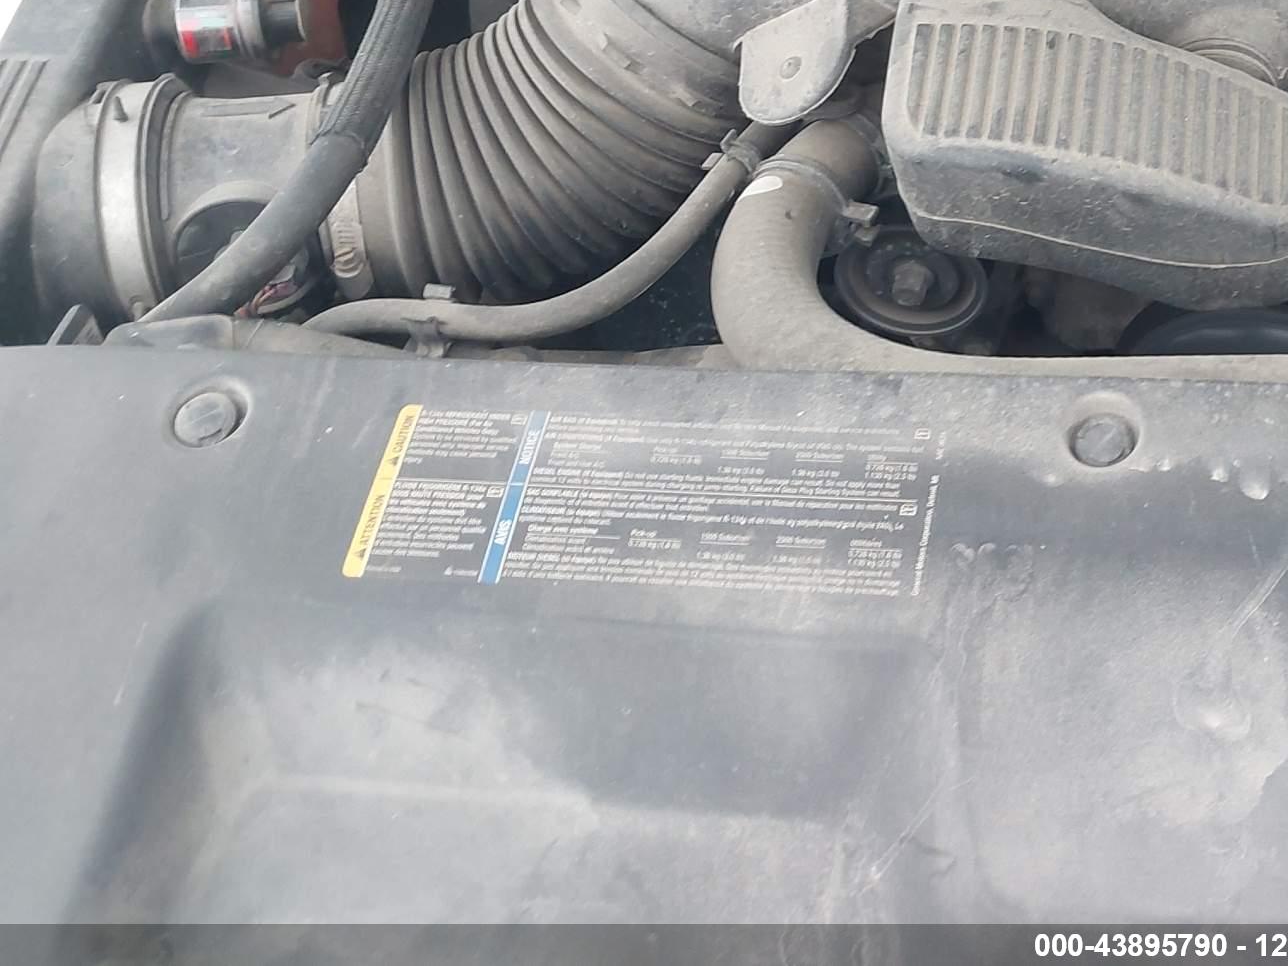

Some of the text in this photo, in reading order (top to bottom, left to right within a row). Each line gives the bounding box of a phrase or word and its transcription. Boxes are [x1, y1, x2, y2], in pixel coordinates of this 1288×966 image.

[392, 414, 415, 454] CAUTION
[519, 429, 541, 465] NOTICE
[364, 494, 386, 549] ATTENTION
[493, 519, 513, 545] AVIS
[914, 547, 928, 570] Motors
